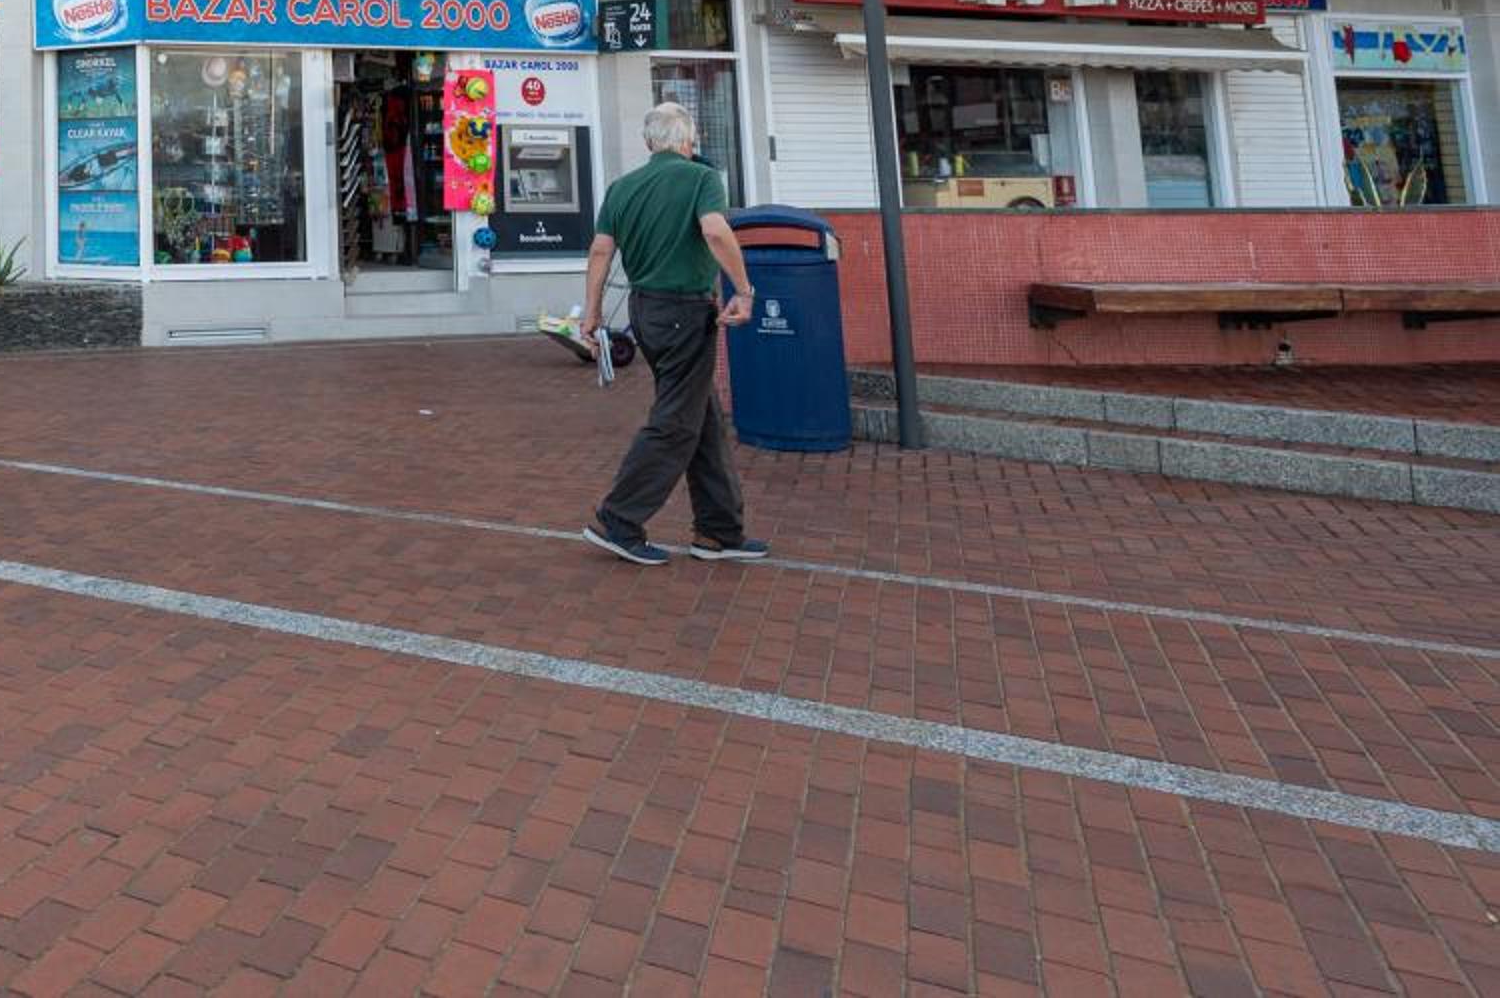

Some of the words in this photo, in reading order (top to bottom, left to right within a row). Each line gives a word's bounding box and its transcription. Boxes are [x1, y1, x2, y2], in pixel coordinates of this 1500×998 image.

[630, 2, 652, 22] 24
[484, 59, 518, 69] BAZAR
[520, 60, 554, 71] CAROL
[556, 61, 579, 71] 2000
[526, 80, 541, 91] 40
[67, 128, 94, 139] CLEAR
